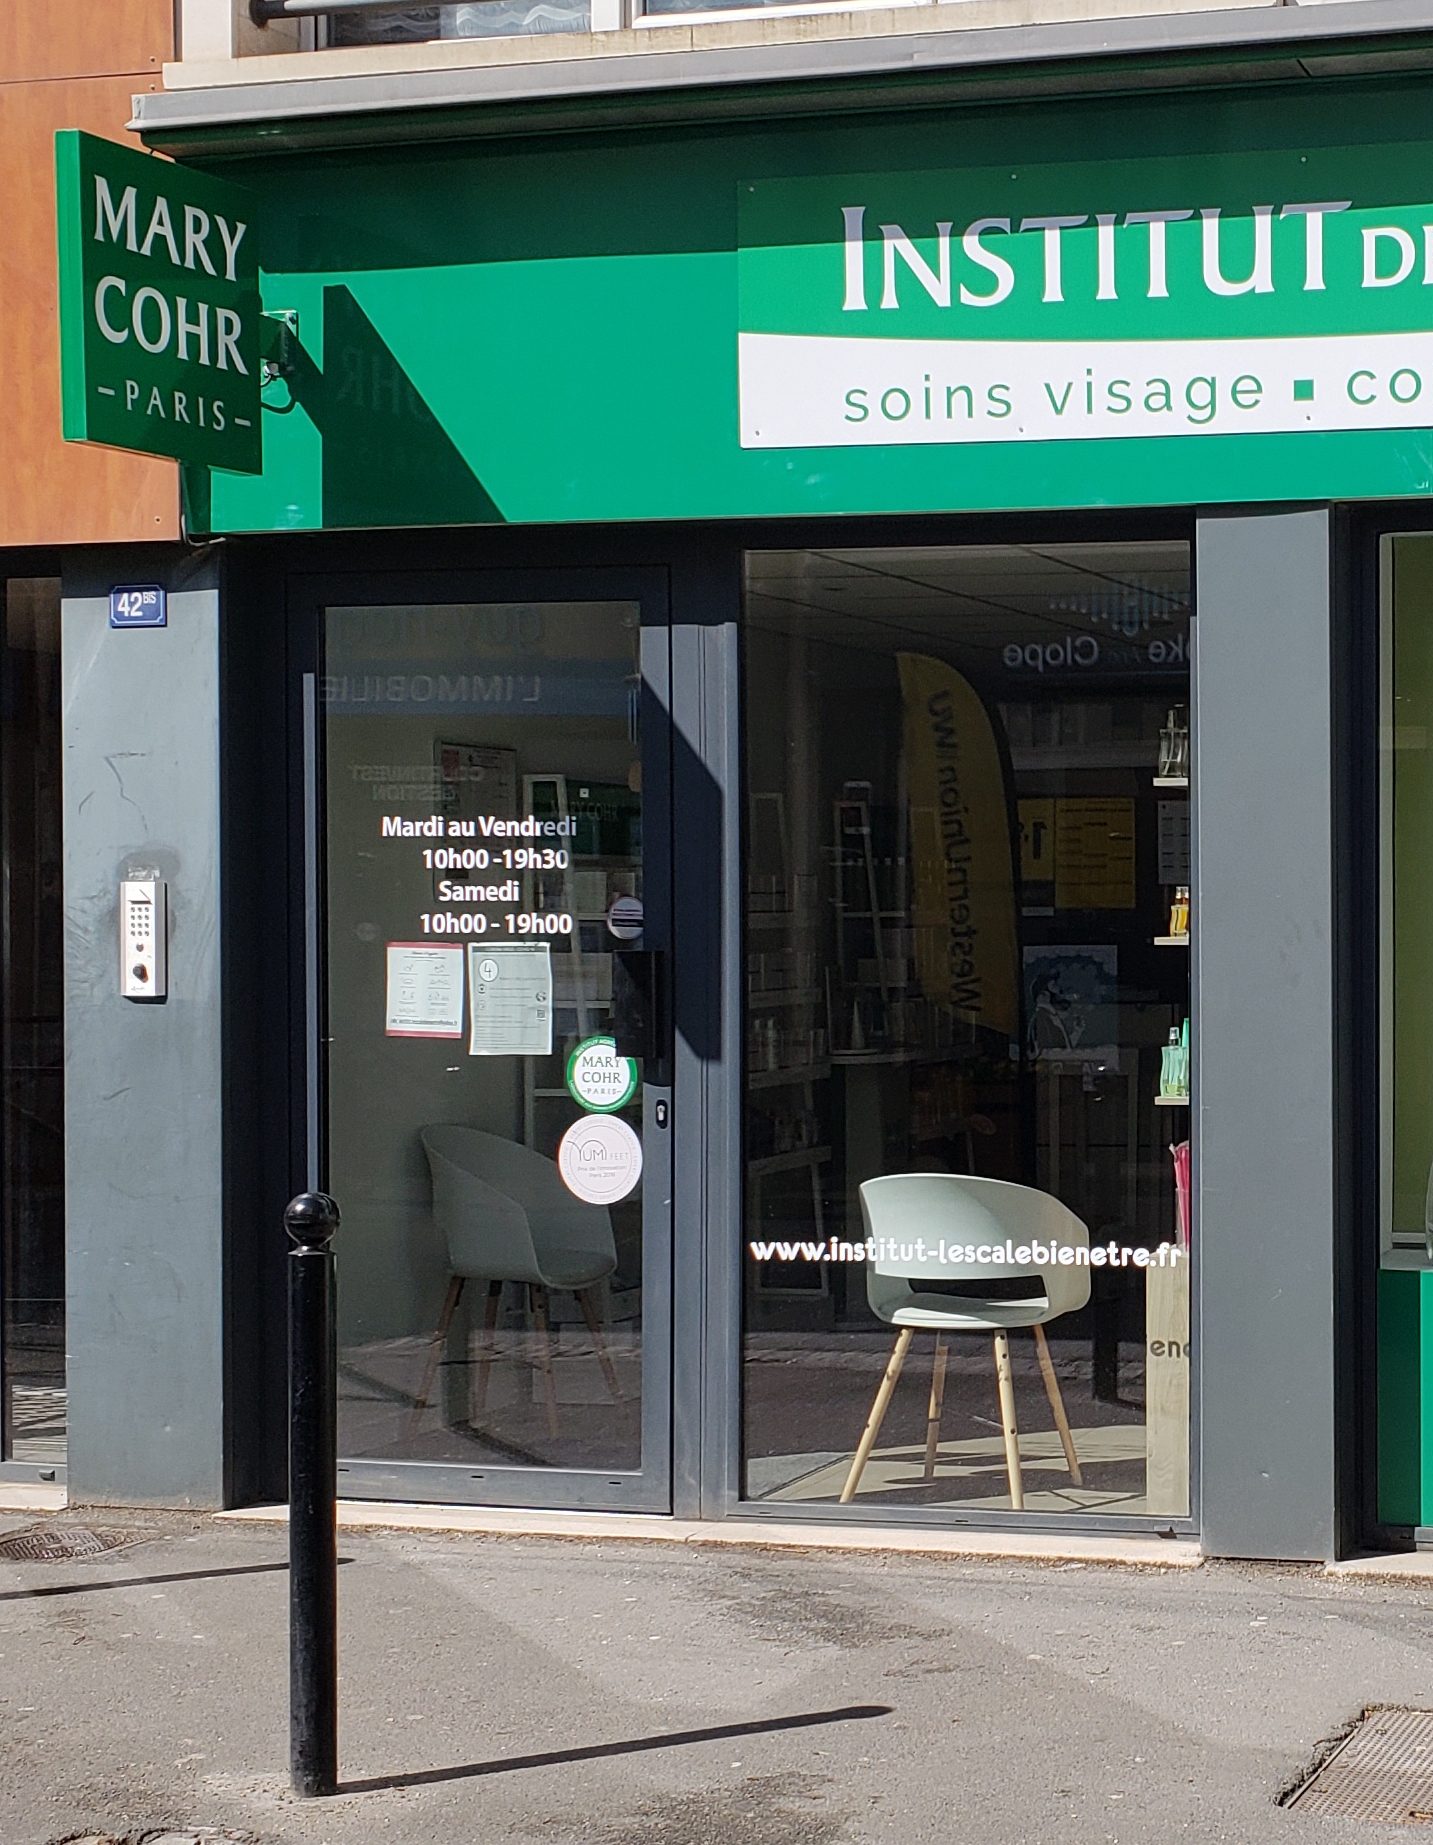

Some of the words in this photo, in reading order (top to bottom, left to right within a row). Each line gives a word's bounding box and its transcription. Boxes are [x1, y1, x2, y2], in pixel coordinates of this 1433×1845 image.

[94, 174, 247, 283] MARY
[841, 200, 1352, 311] INSTITUT
[95, 275, 249, 375] COHR
[844, 374, 1013, 423] soins
[1044, 367, 1263, 425] visage
[381, 815, 444, 837] Mardi
[448, 820, 476, 837] au
[477, 815, 577, 837] Vendredi
[422, 848, 489, 869] 10h00
[438, 879, 520, 901] Samedi
[420, 912, 487, 934] 10h00
[505, 912, 572, 934] 19h00
[581, 1056, 621, 1068] MARY
[581, 1071, 622, 1084] COHR
[750, 1236, 1182, 1268] www.institut-lescalebienetre.fr
